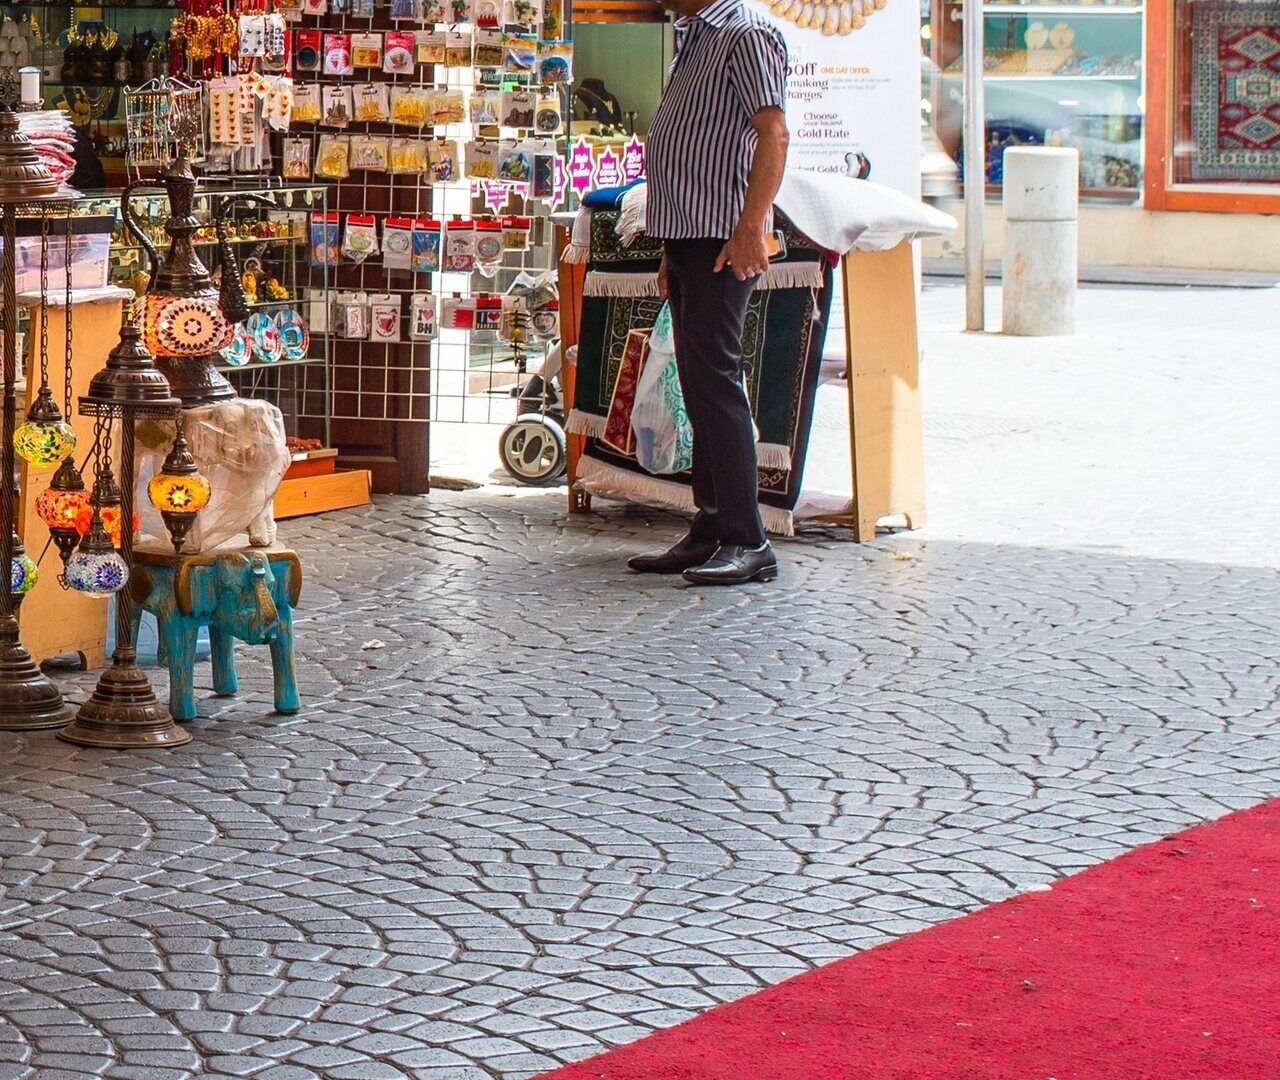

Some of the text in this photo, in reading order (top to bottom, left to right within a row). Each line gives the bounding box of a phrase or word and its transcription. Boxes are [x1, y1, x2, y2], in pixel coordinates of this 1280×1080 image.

[794, 62, 817, 76] Off
[790, 79, 828, 90] making
[804, 111, 838, 120] Choose
[797, 128, 850, 138] Gold Rate
[817, 165, 838, 173] Gold
